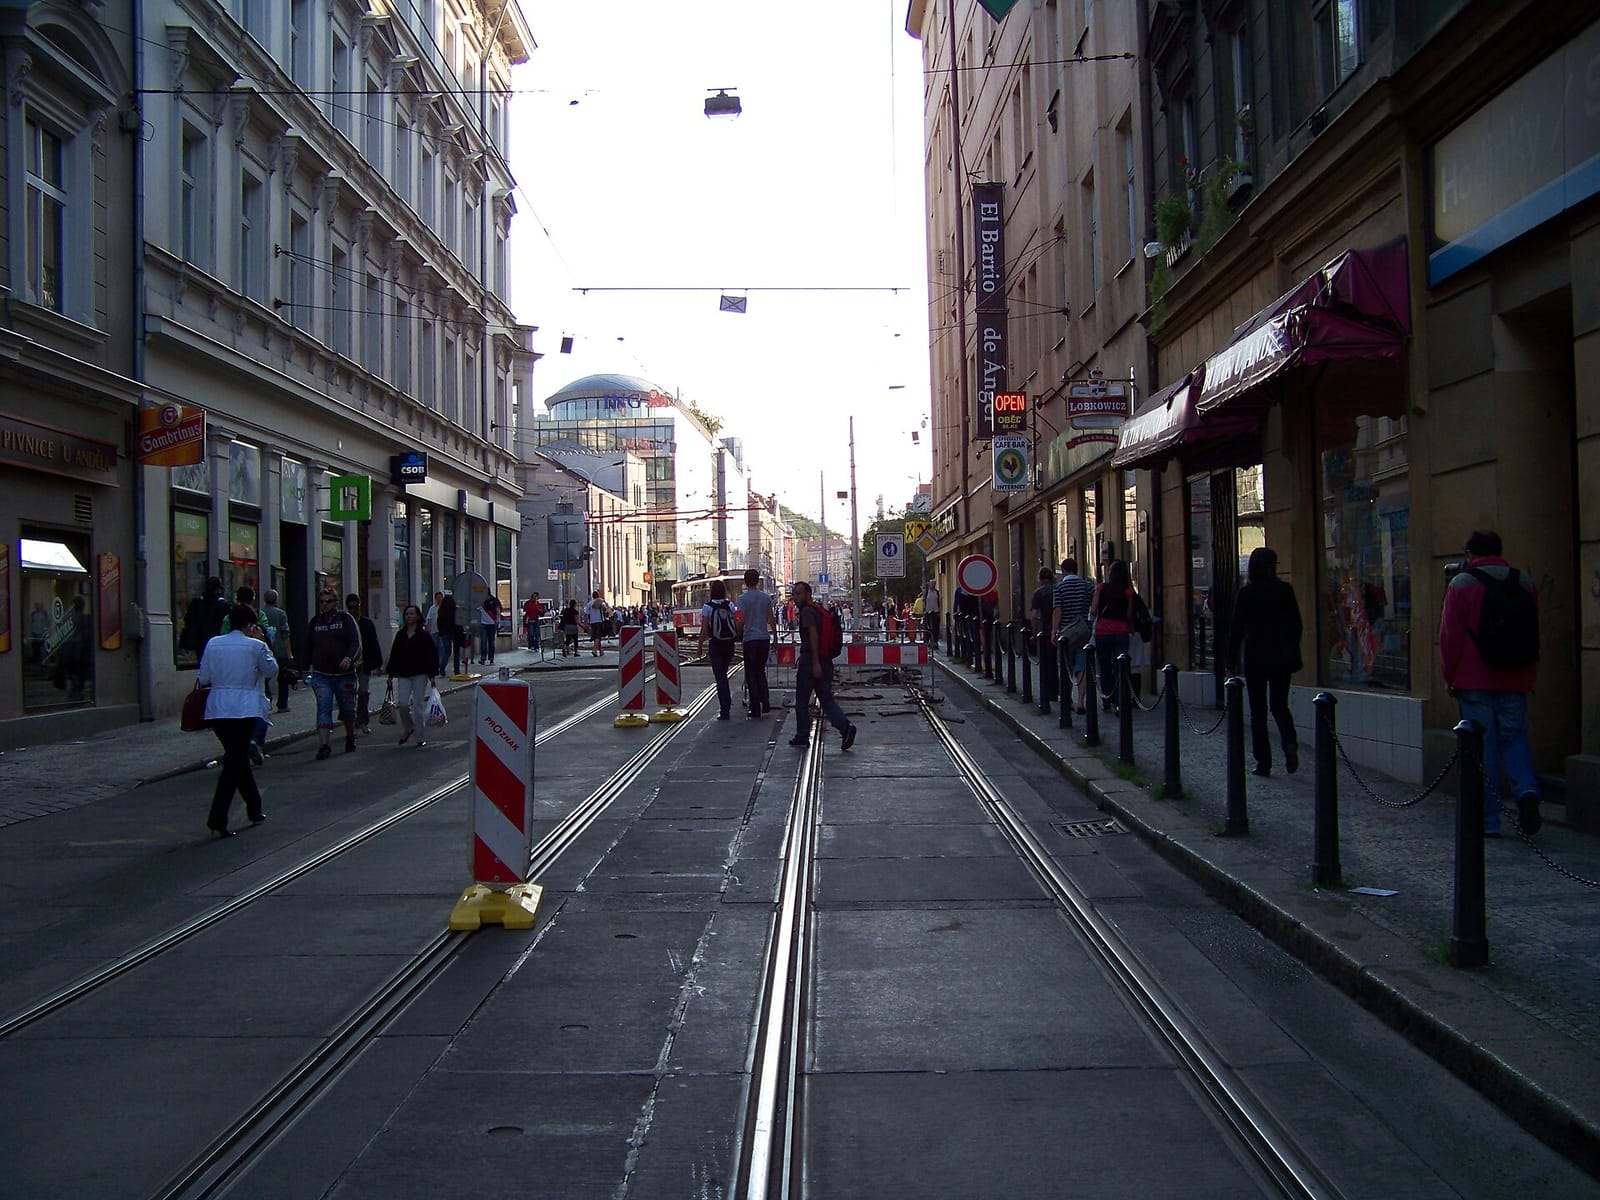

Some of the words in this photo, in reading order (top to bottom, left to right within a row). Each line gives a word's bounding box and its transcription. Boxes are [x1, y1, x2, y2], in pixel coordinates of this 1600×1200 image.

[981, 202, 999, 223] El
[981, 229, 1001, 294] Barrio
[983, 328, 1001, 353] de
[604, 392, 640, 409] ING
[995, 395, 1025, 411] OPEN
[1069, 402, 1127, 412] LOBKOWICZ
[2, 430, 55, 459] PIVNICE
[63, 445, 71, 463] U
[141, 424, 201, 452] Gambrinus
[484, 716, 520, 751] PROZNAK
